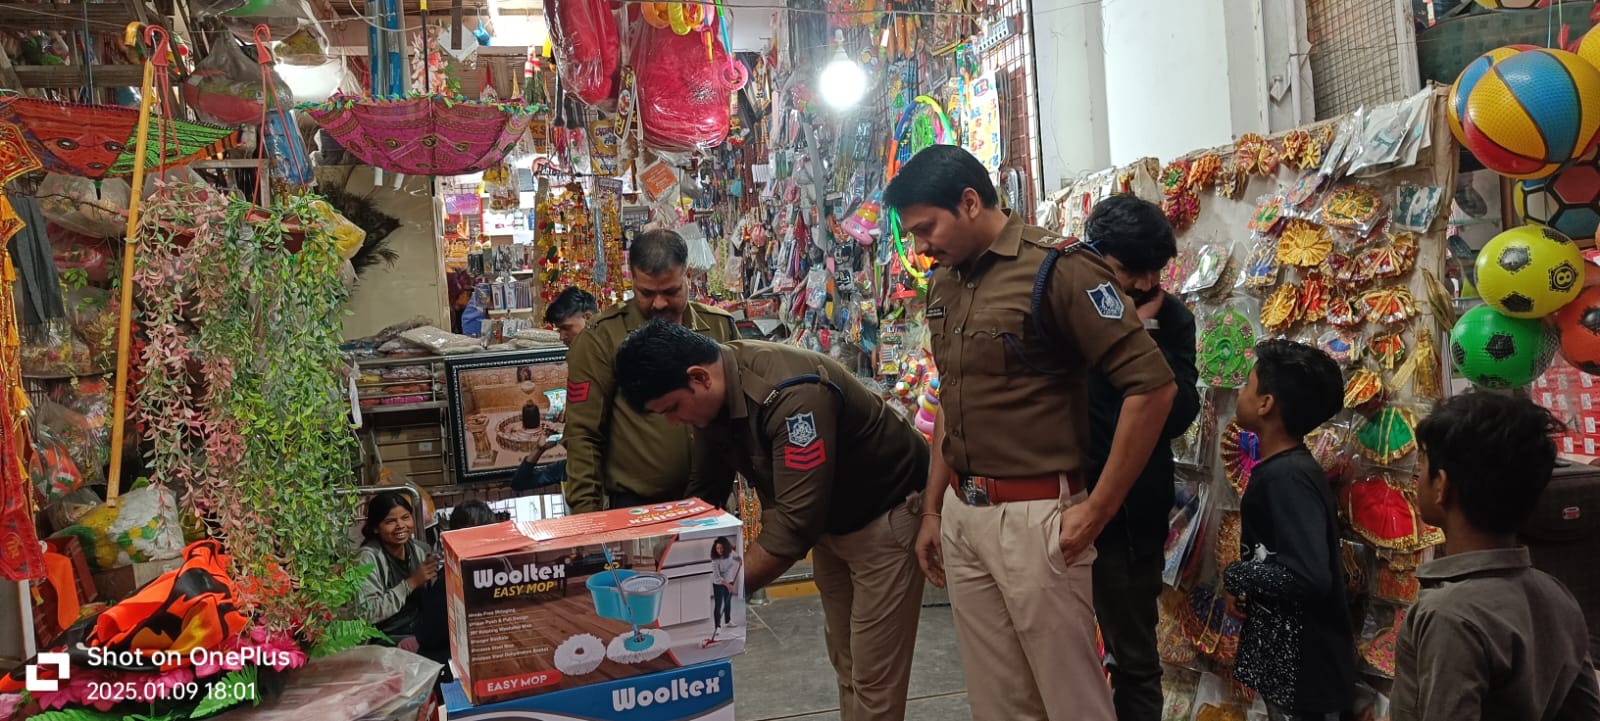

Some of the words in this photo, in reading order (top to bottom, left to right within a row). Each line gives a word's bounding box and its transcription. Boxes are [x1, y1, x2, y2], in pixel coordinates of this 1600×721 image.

[473, 563, 566, 589] Wooltex
[493, 584, 525, 599] EASY
[526, 581, 554, 594] MOP
[487, 678, 521, 693] EASY
[524, 674, 548, 688] MOP
[612, 676, 721, 712] Wooltex
